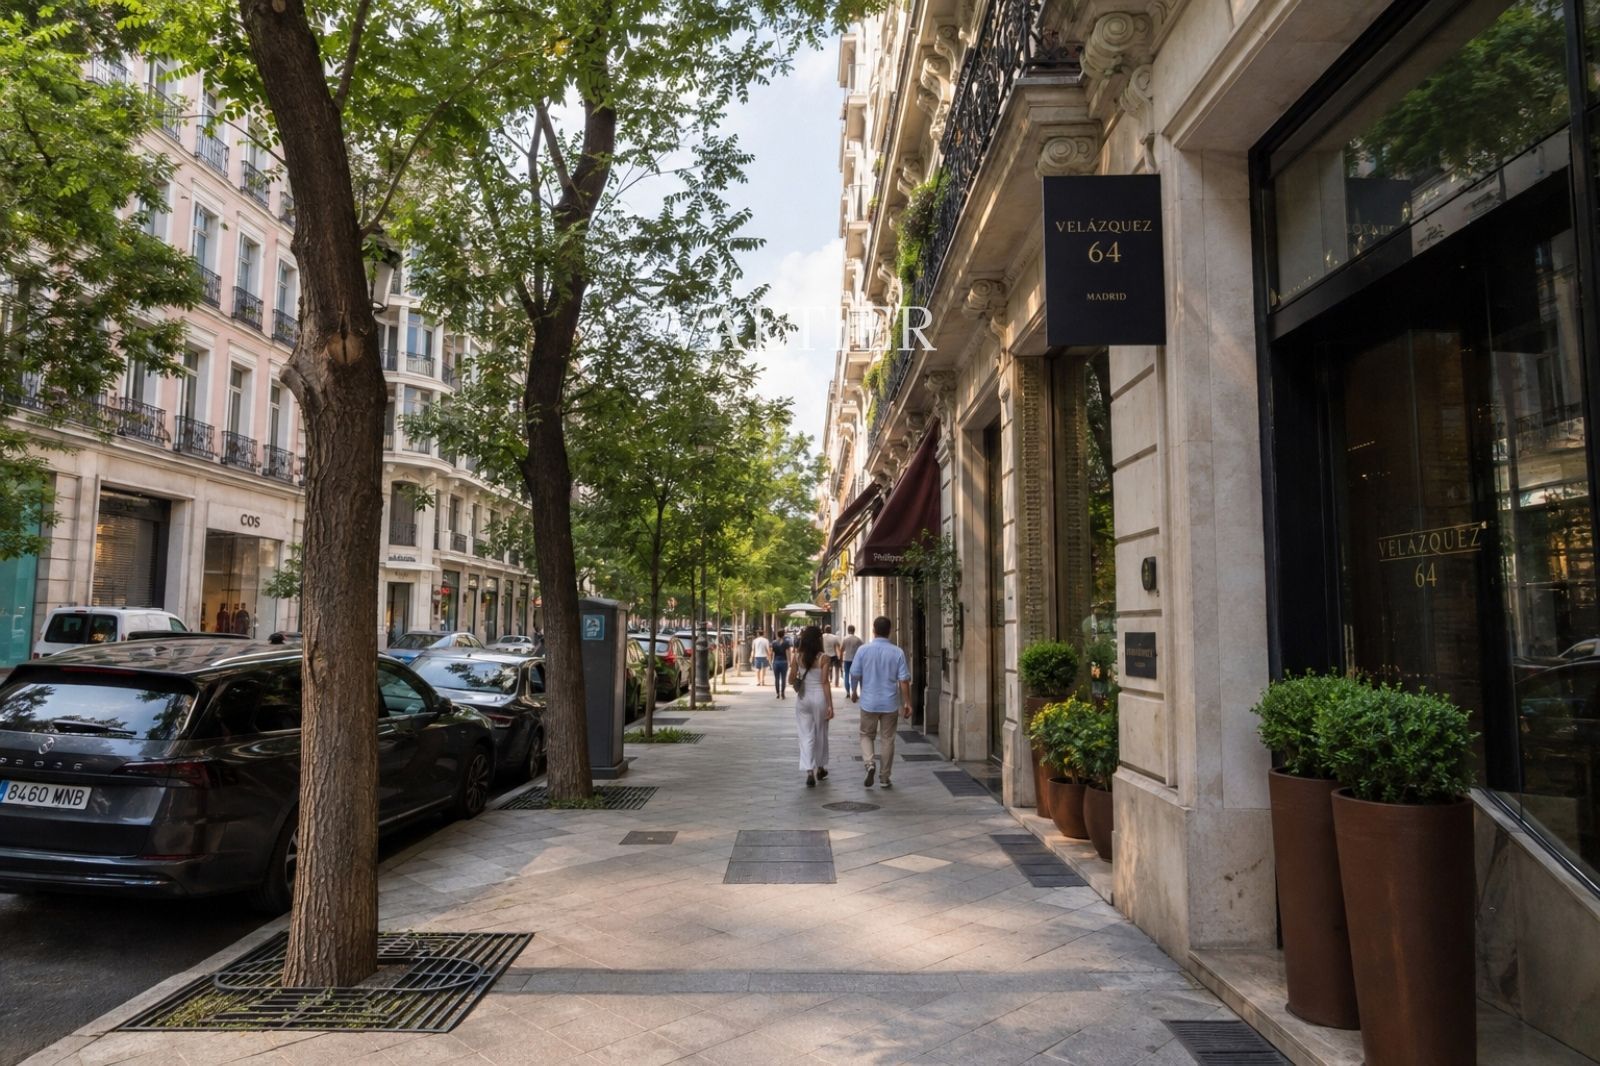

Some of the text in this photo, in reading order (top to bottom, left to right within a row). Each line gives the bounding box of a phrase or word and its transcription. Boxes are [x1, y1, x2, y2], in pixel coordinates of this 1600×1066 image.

[1055, 218, 1153, 233] VELÁZQUEZ
[1088, 241, 1122, 264] 64
[1086, 292, 1127, 301] MADRID
[240, 513, 261, 528] COS
[1415, 563, 1437, 588] 64
[7, 784, 85, 807] 8460 MNB
